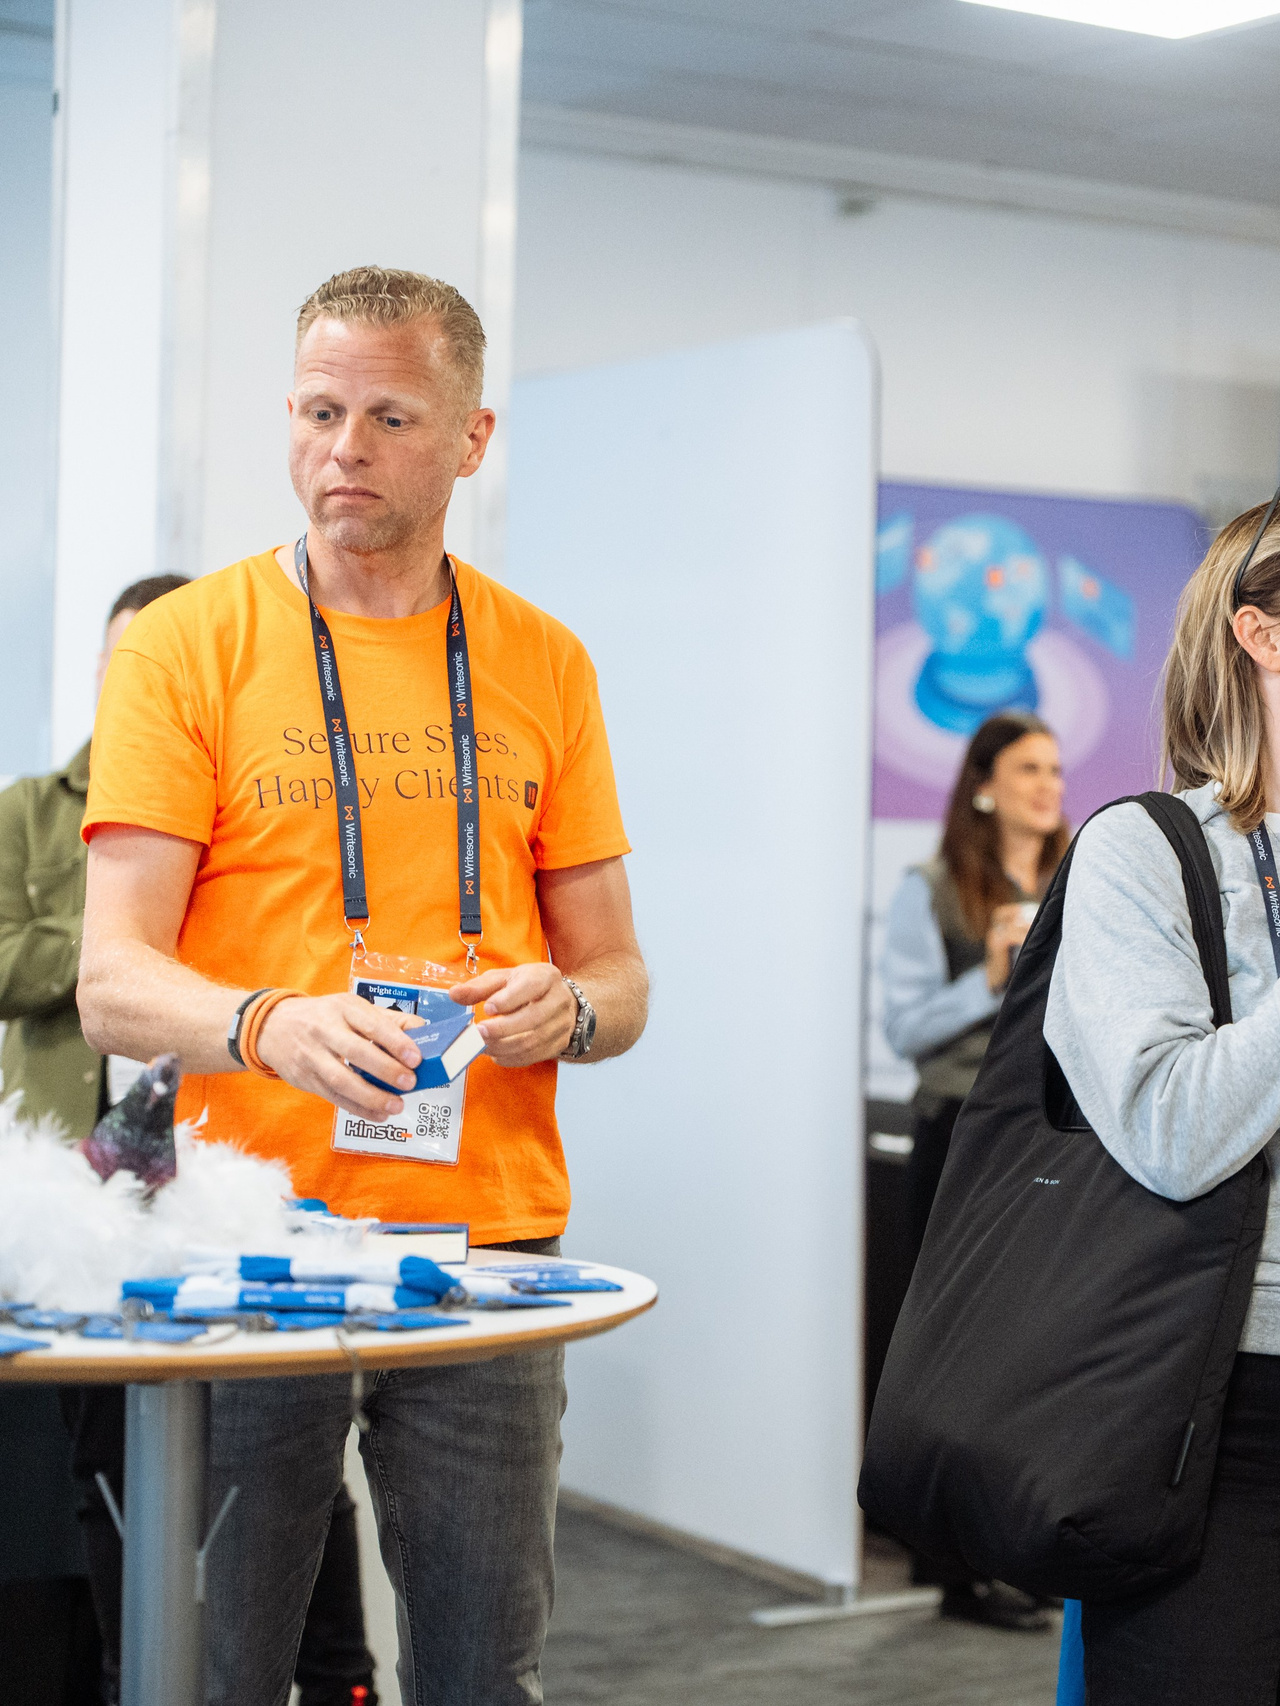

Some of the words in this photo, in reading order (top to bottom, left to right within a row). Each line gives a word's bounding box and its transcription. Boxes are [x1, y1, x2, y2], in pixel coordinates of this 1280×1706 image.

[321, 651, 337, 702] Writesonic
[456, 651, 466, 702] Writesonic
[283, 727, 412, 756] Seure
[334, 734, 351, 787] Writesonic
[460, 734, 473, 787] Writesonic
[253, 775, 380, 809] Hapy
[345, 822, 357, 879] Writesonic
[465, 822, 475, 878] Writesonic
[369, 985, 392, 996] bright
[392, 988, 408, 997] data
